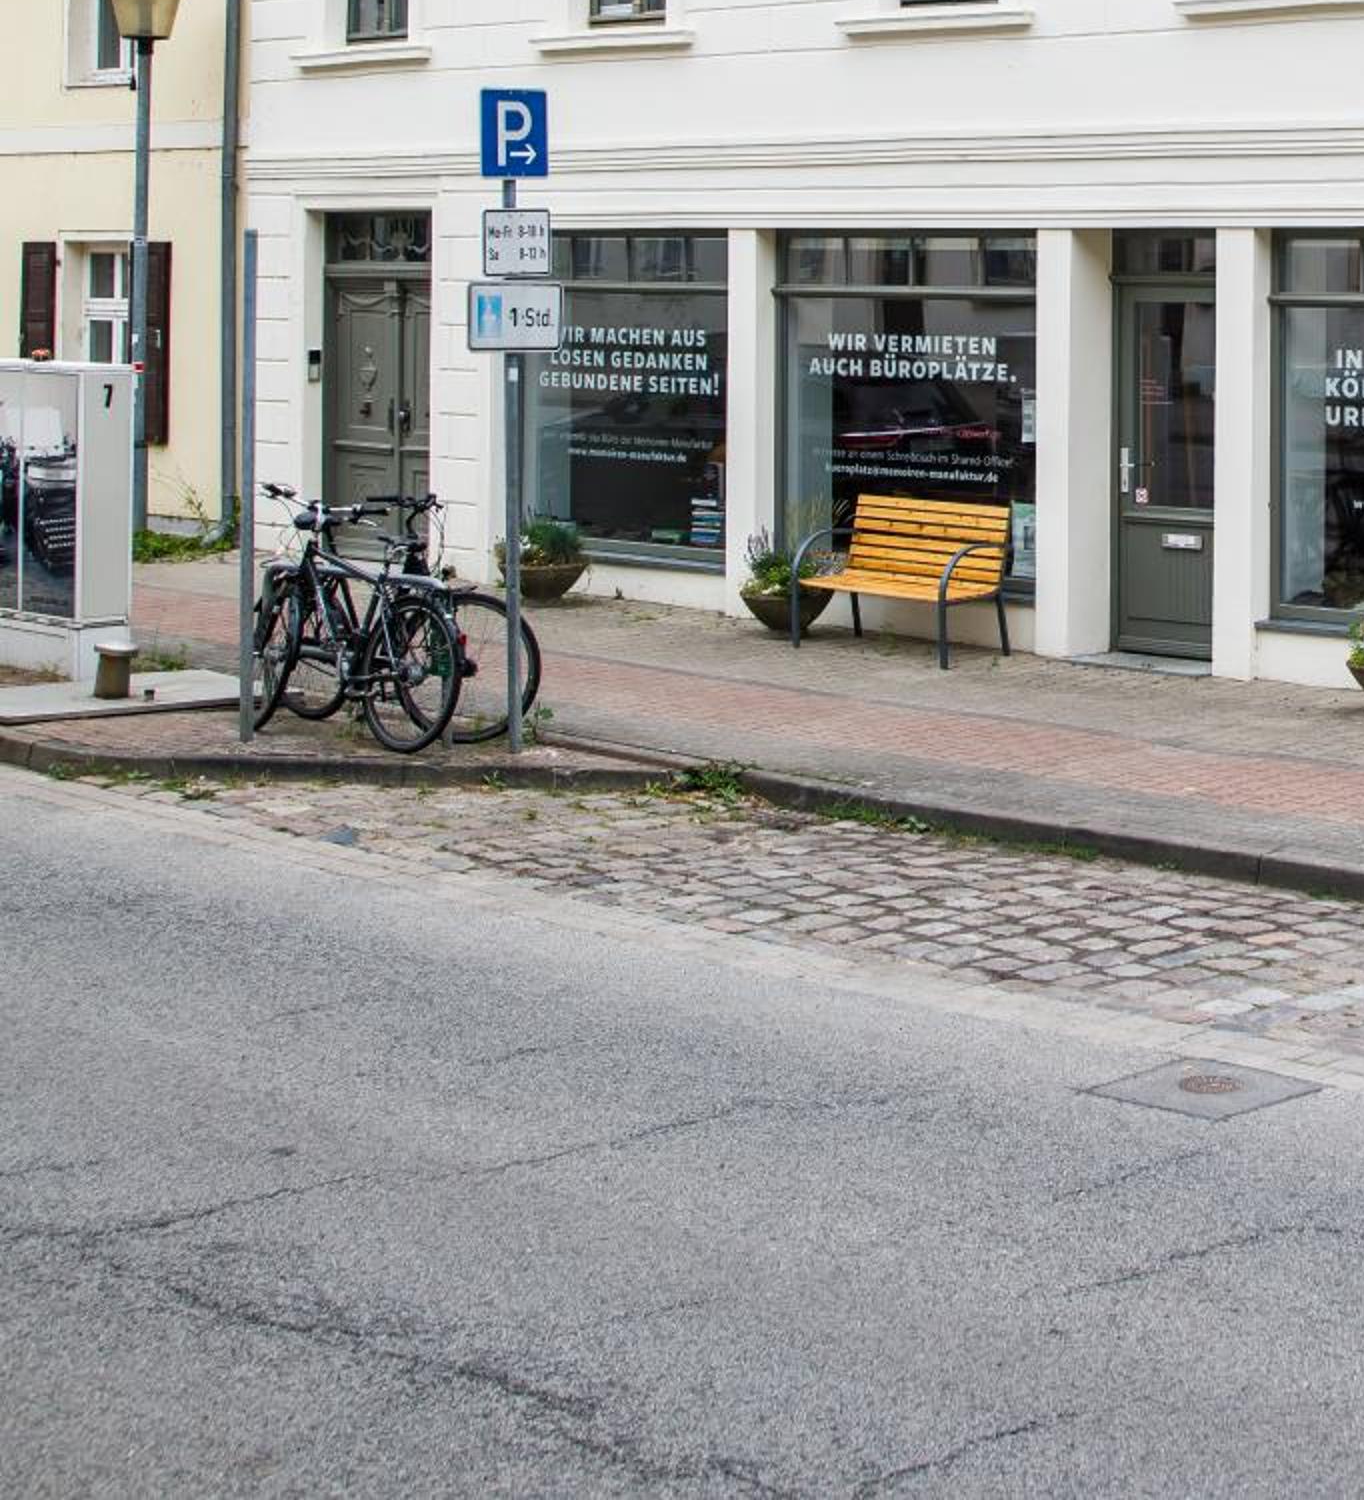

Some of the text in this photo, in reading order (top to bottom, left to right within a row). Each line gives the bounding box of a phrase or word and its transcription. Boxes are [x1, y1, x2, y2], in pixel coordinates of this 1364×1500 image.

[497, 100, 533, 166] P
[488, 247, 499, 260] Sa
[591, 327, 665, 345] MACHEN
[671, 329, 706, 347] AUS
[828, 333, 996, 356] WIR VERMIETEN
[551, 350, 708, 370] LOSEN GEDANKEN
[809, 354, 1016, 382] AUCH BÜROPLÄTZE.
[1336, 350, 1362, 369] IN
[539, 372, 719, 396] GEBUNDENE SEITEN!
[103, 384, 113, 408] 7
